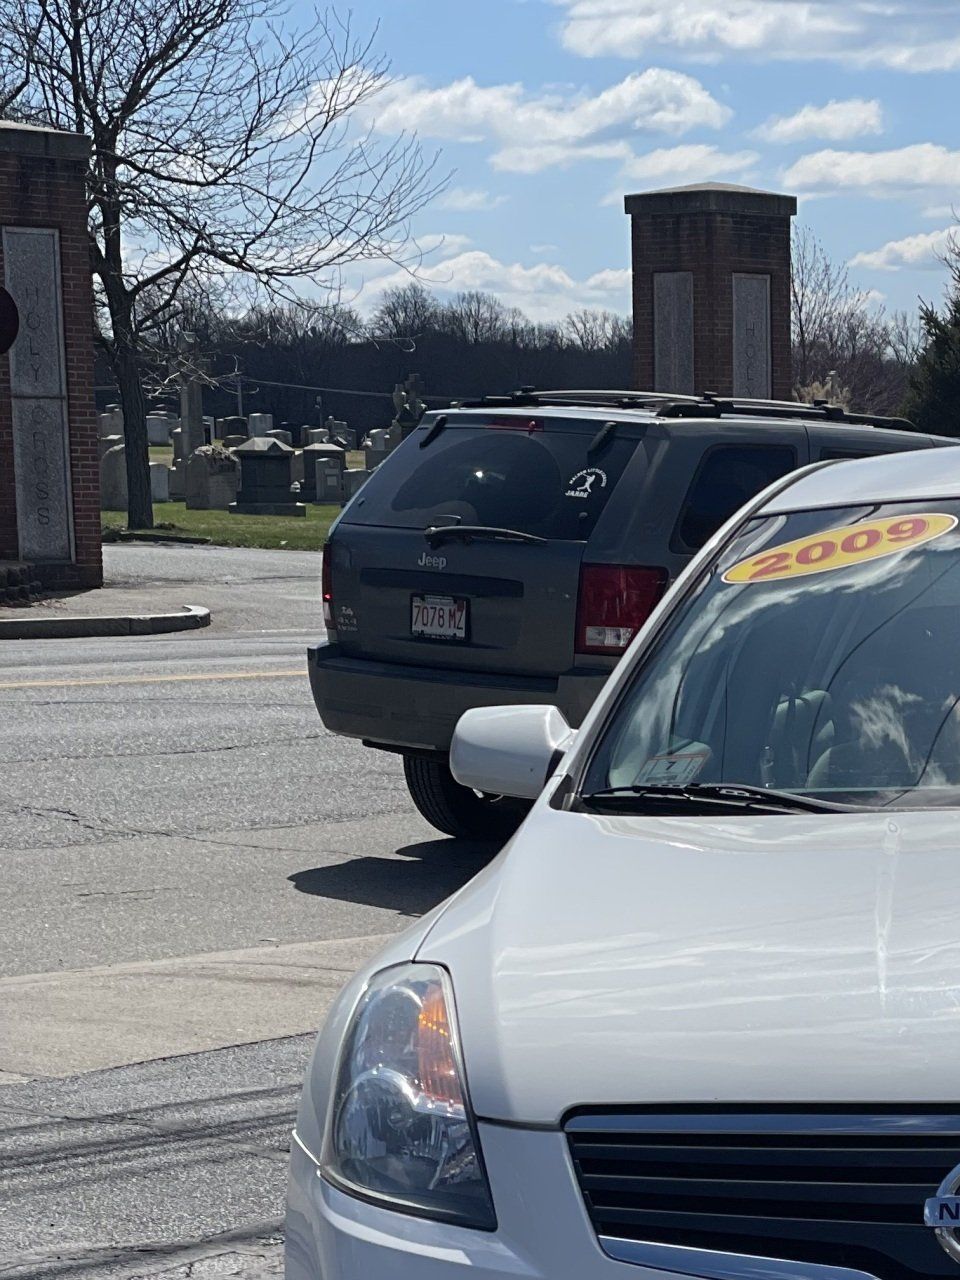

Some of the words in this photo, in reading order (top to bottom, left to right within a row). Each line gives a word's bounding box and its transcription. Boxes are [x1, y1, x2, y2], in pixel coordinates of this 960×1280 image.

[26, 286, 41, 382] HOLY
[31, 406, 50, 526] CROSS
[418, 552, 447, 570] Jeep
[748, 518, 929, 581] 2009
[413, 604, 445, 628] 7078
[448, 607, 464, 630] MZ
